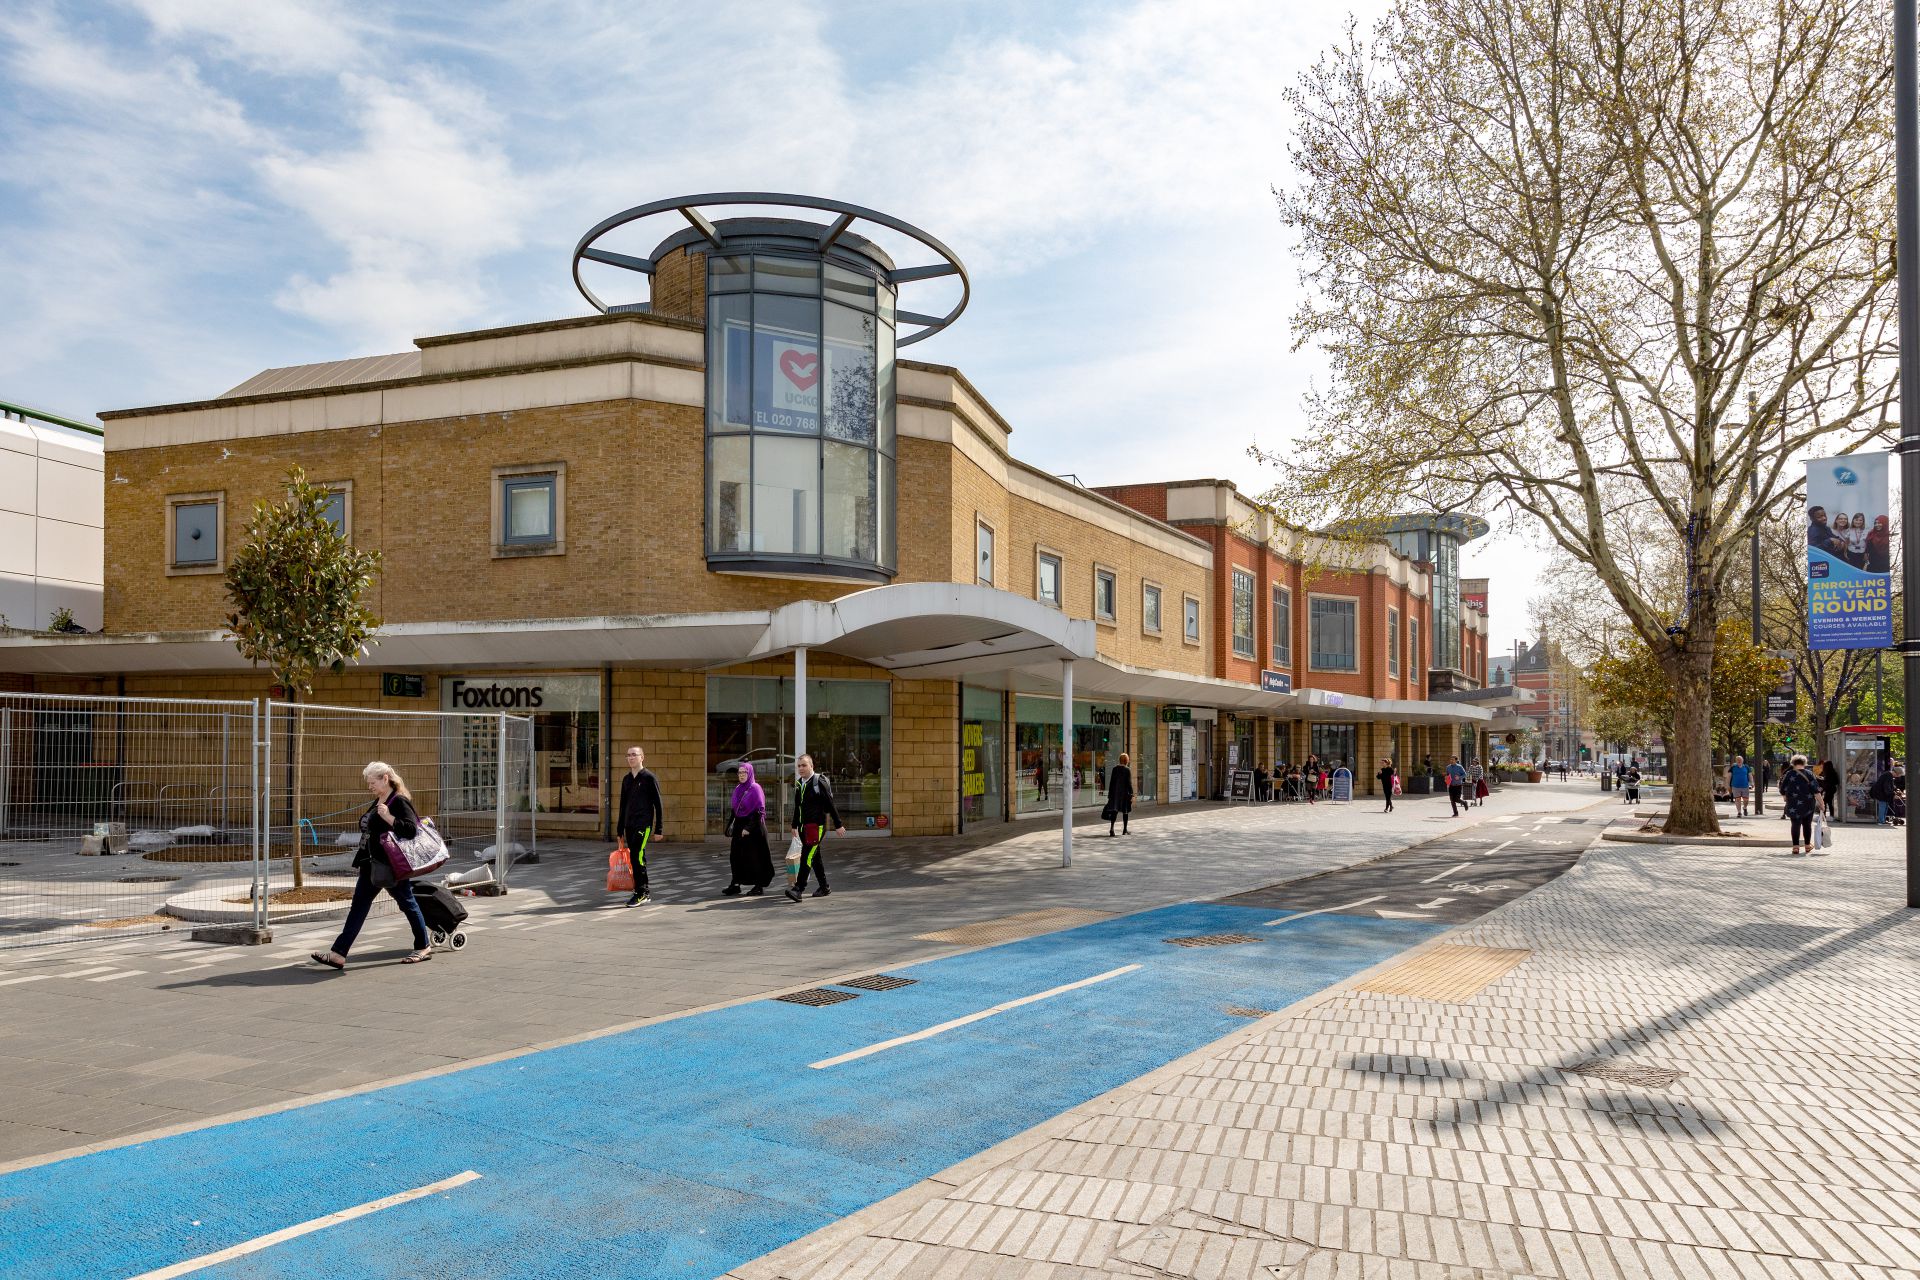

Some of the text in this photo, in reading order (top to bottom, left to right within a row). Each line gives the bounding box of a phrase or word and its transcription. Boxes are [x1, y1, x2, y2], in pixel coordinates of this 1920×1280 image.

[754, 410, 769, 424] EL
[771, 413, 792, 426] 020
[795, 416, 818, 430] 768
[1813, 578, 1886, 590] ENROLLING
[1812, 588, 1887, 601] ALL YEAR
[1812, 598, 1888, 614] ROUND
[452, 680, 543, 708] Foxtons
[1090, 705, 1121, 725] Foxtons
